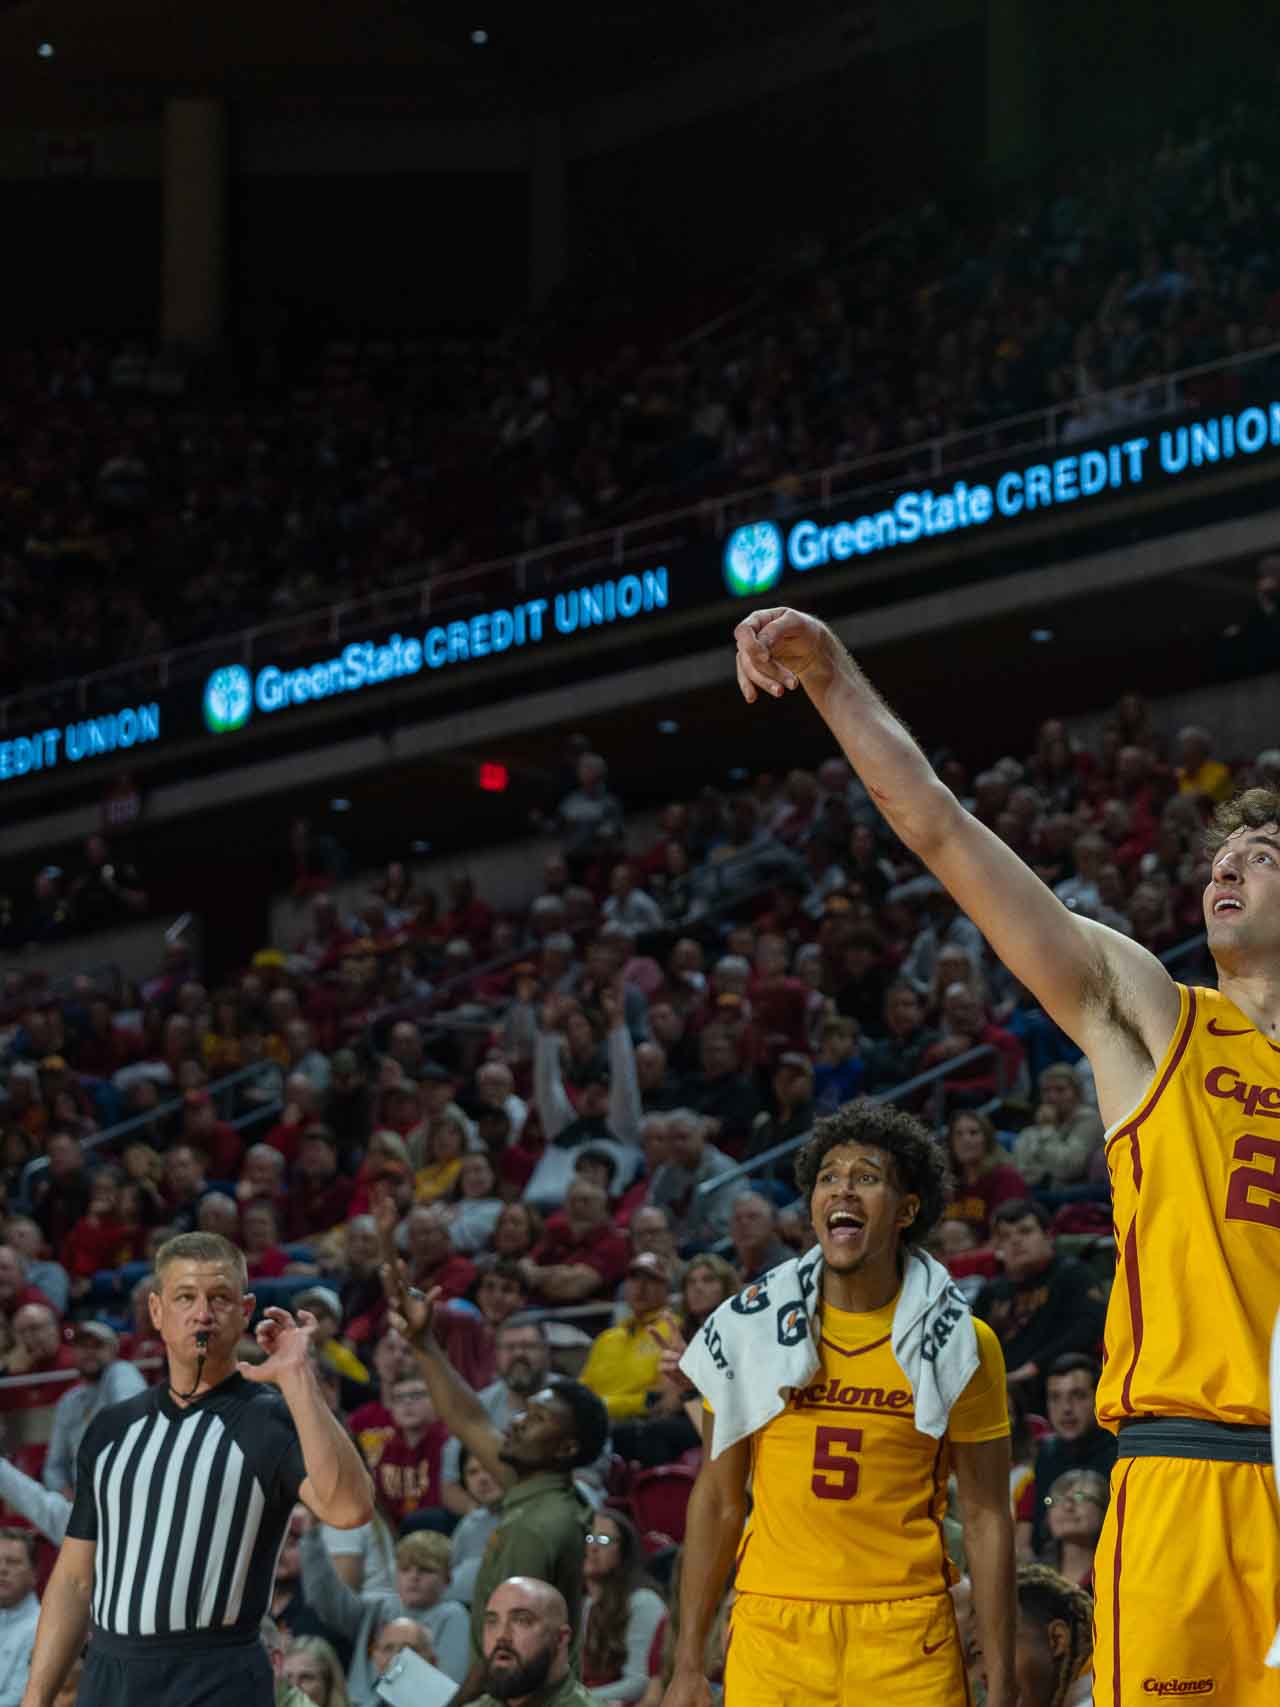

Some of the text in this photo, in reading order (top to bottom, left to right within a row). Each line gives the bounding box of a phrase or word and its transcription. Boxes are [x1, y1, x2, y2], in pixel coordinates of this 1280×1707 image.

[787, 480, 994, 571] GreenState
[995, 437, 1149, 517] CREDIT
[256, 567, 668, 712] GreenState CREDIT UNION
[66, 703, 160, 761] UNION
[789, 1378, 914, 1410] yclone
[811, 1425, 864, 1501] 5
[1142, 1679, 1215, 1696] Cyclones
